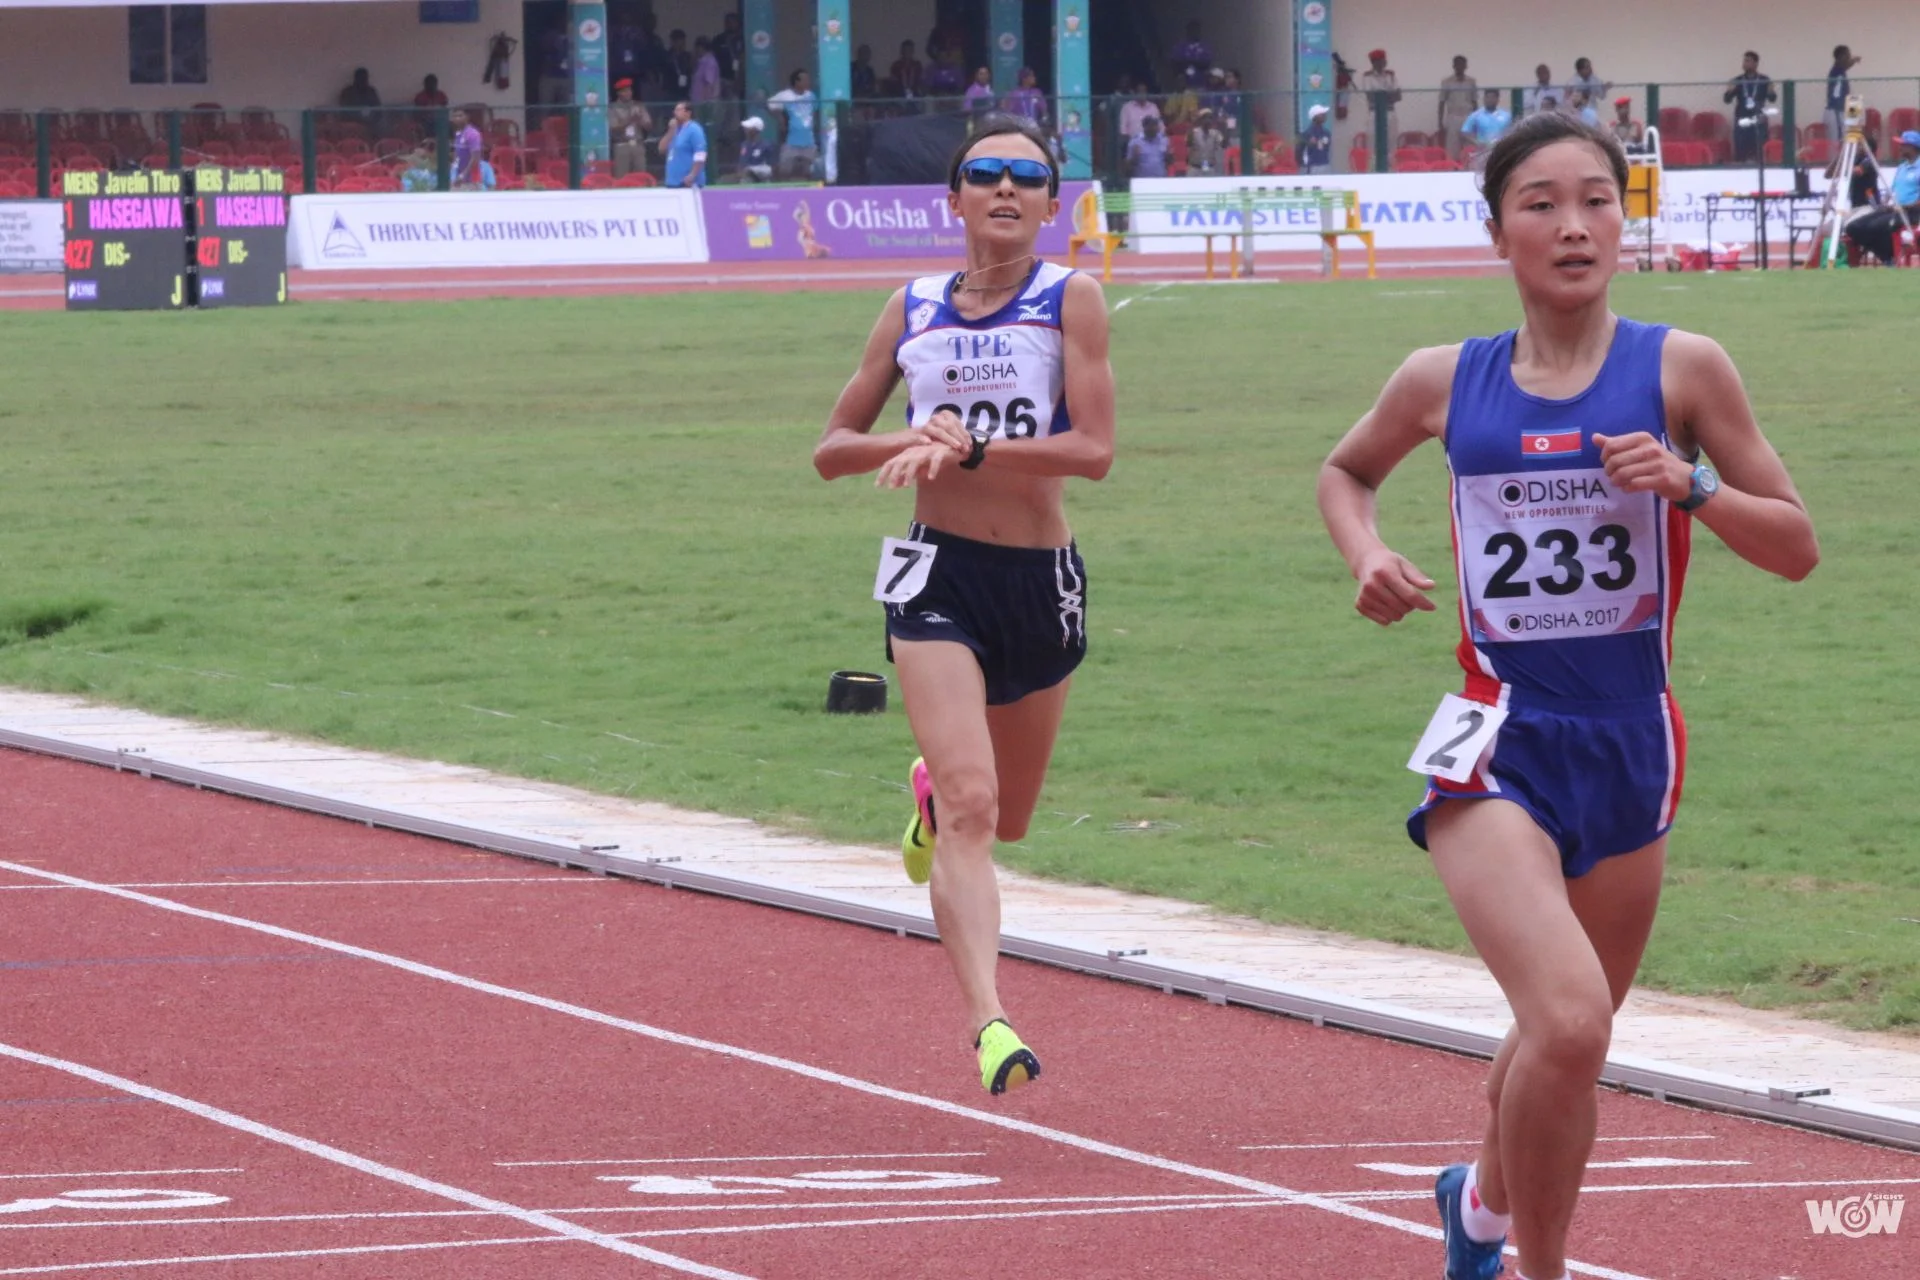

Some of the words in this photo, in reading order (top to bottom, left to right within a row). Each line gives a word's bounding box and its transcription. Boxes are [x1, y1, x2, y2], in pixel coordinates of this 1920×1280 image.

[64, 171, 98, 195] MENS
[105, 171, 149, 195] Javelin
[152, 170, 180, 193] Thro
[195, 169, 223, 192] MENS
[227, 169, 260, 192] Javelin
[261, 169, 283, 192] Thro
[65, 200, 74, 229] 1
[89, 197, 183, 229] HASEGAWA
[216, 196, 285, 227] HASEGAWA
[827, 198, 927, 230] Odisha
[1164, 203, 1244, 226] TATA
[1252, 203, 1320, 225] STEE
[1360, 201, 1436, 223] TATA
[366, 222, 454, 242] THRIVENI
[459, 219, 598, 241] EARTHMOVERS
[604, 218, 637, 238] PVT
[643, 217, 681, 237] LTD
[65, 238, 94, 269] 427
[197, 236, 221, 267] 427
[171, 275, 182, 305] J
[947, 333, 1012, 360] TPE
[946, 386, 961, 394] NEW
[963, 382, 1017, 393] OPPORTUNITIES
[930, 397, 1038, 440] 06
[1504, 510, 1526, 520] NEW
[1529, 504, 1607, 519] OPPORTUNITIES
[883, 546, 922, 595] 7
[1483, 524, 1637, 599] 233
[1584, 607, 1620, 627] 2017
[1425, 709, 1485, 769] 2
